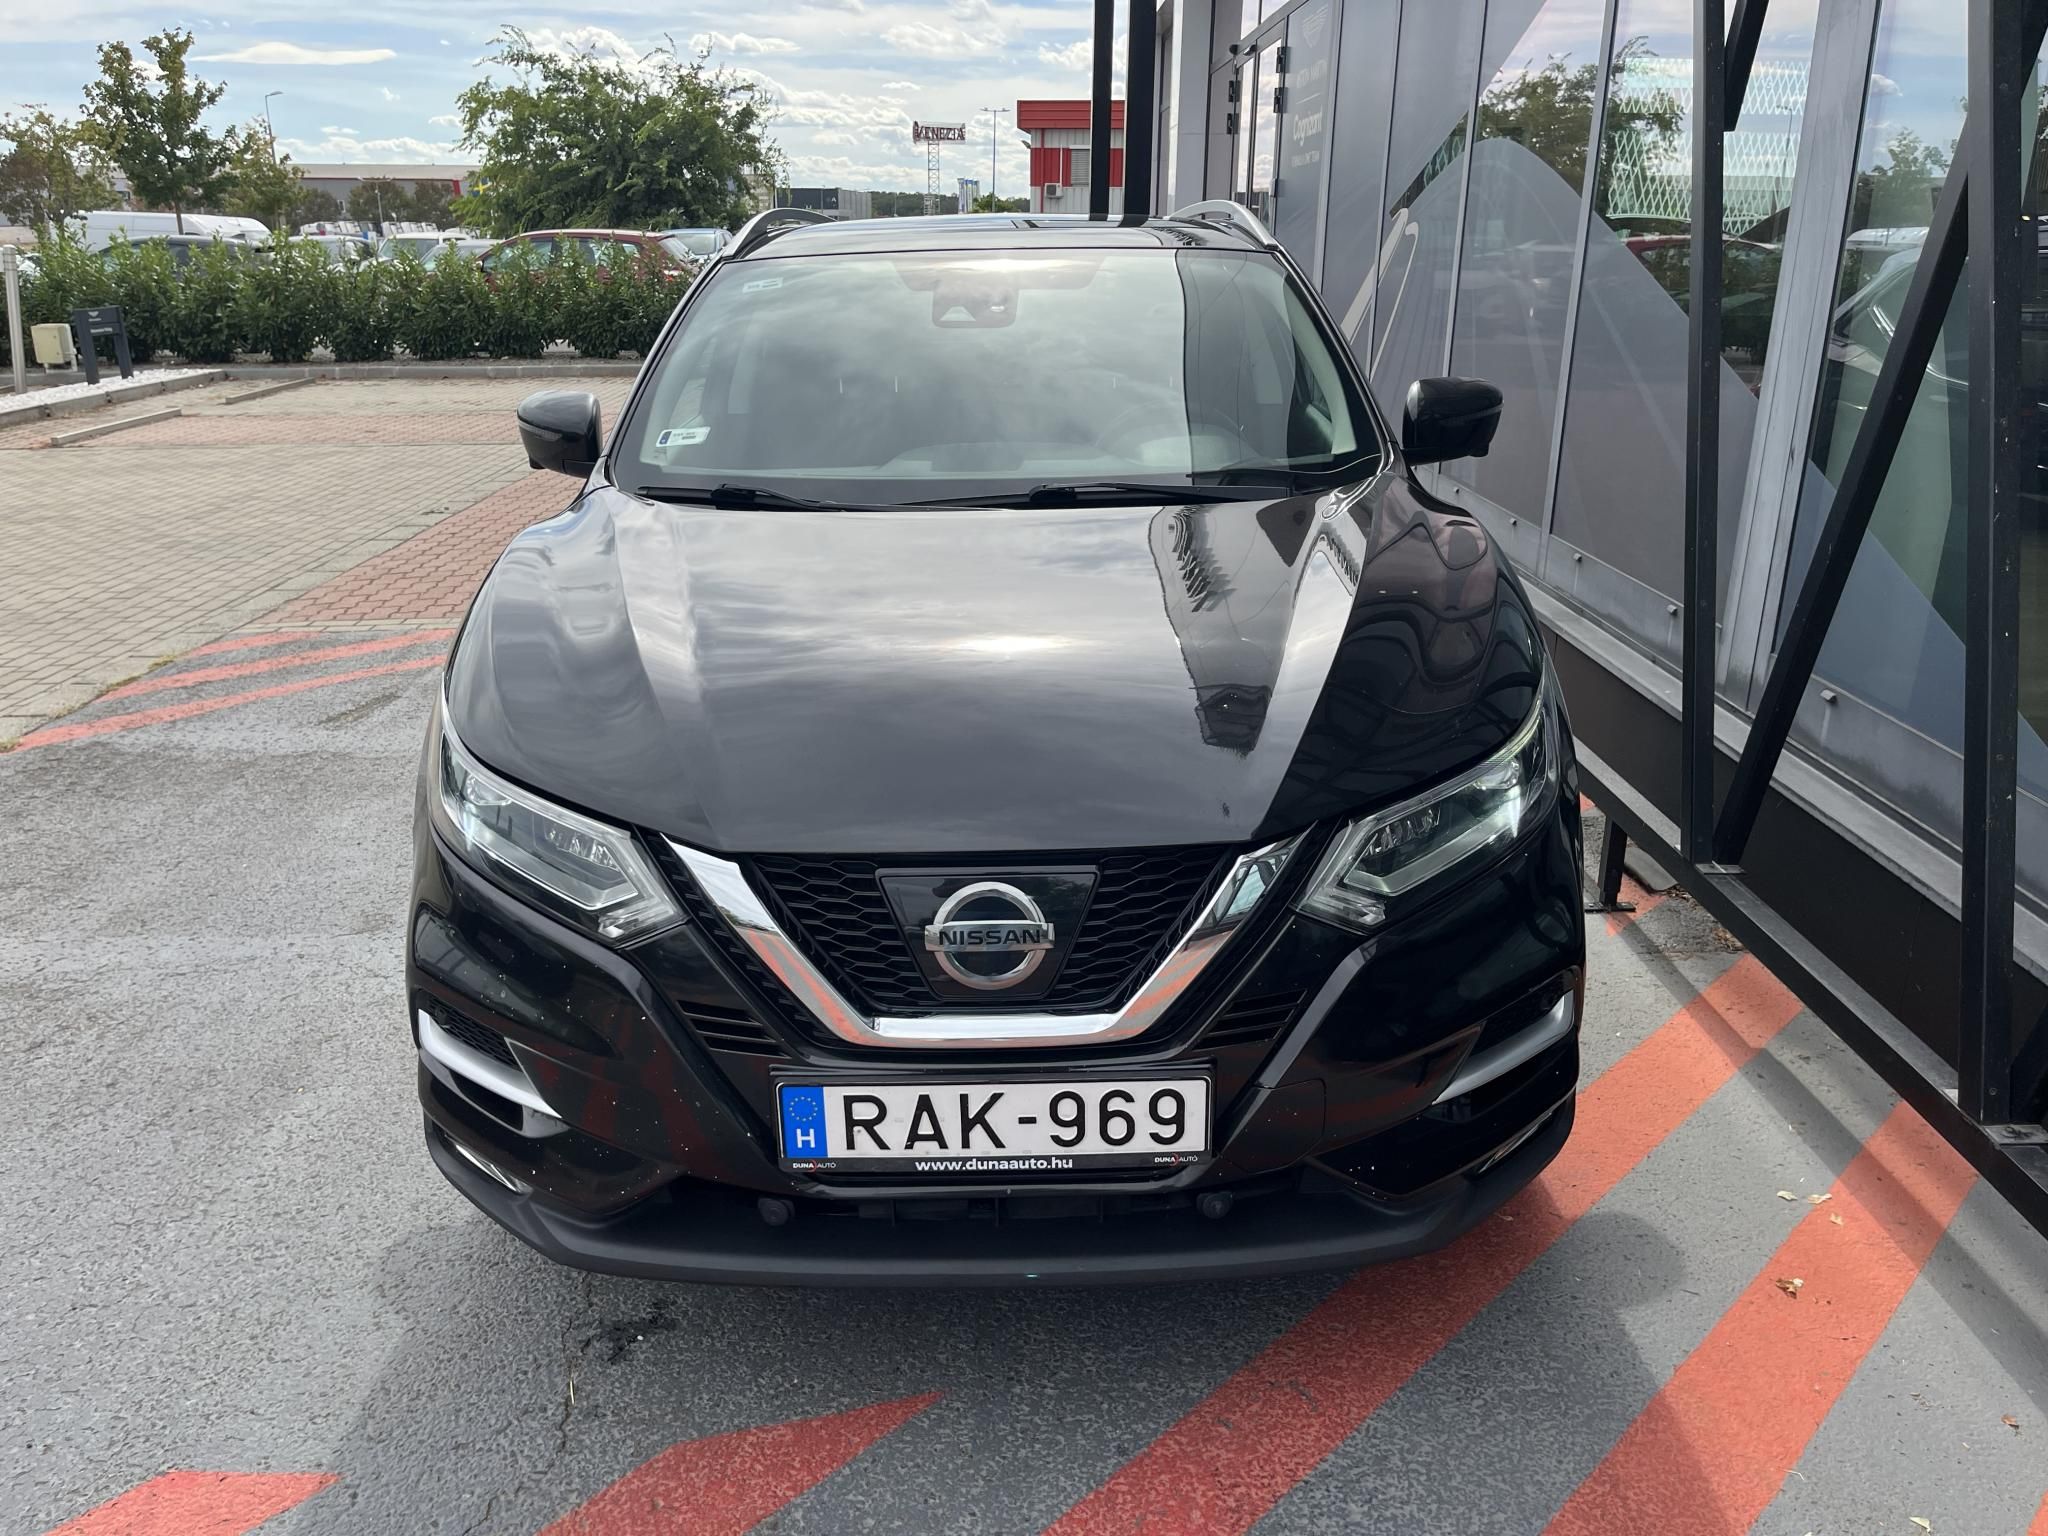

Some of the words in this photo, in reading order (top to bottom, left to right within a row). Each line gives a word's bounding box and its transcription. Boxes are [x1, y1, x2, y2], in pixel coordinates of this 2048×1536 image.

[939, 929, 1041, 946] NISSAN
[842, 1088, 1186, 1151] RAK-969
[797, 1129, 815, 1148] H
[915, 1157, 1073, 1171] www.dunaauto.hu
